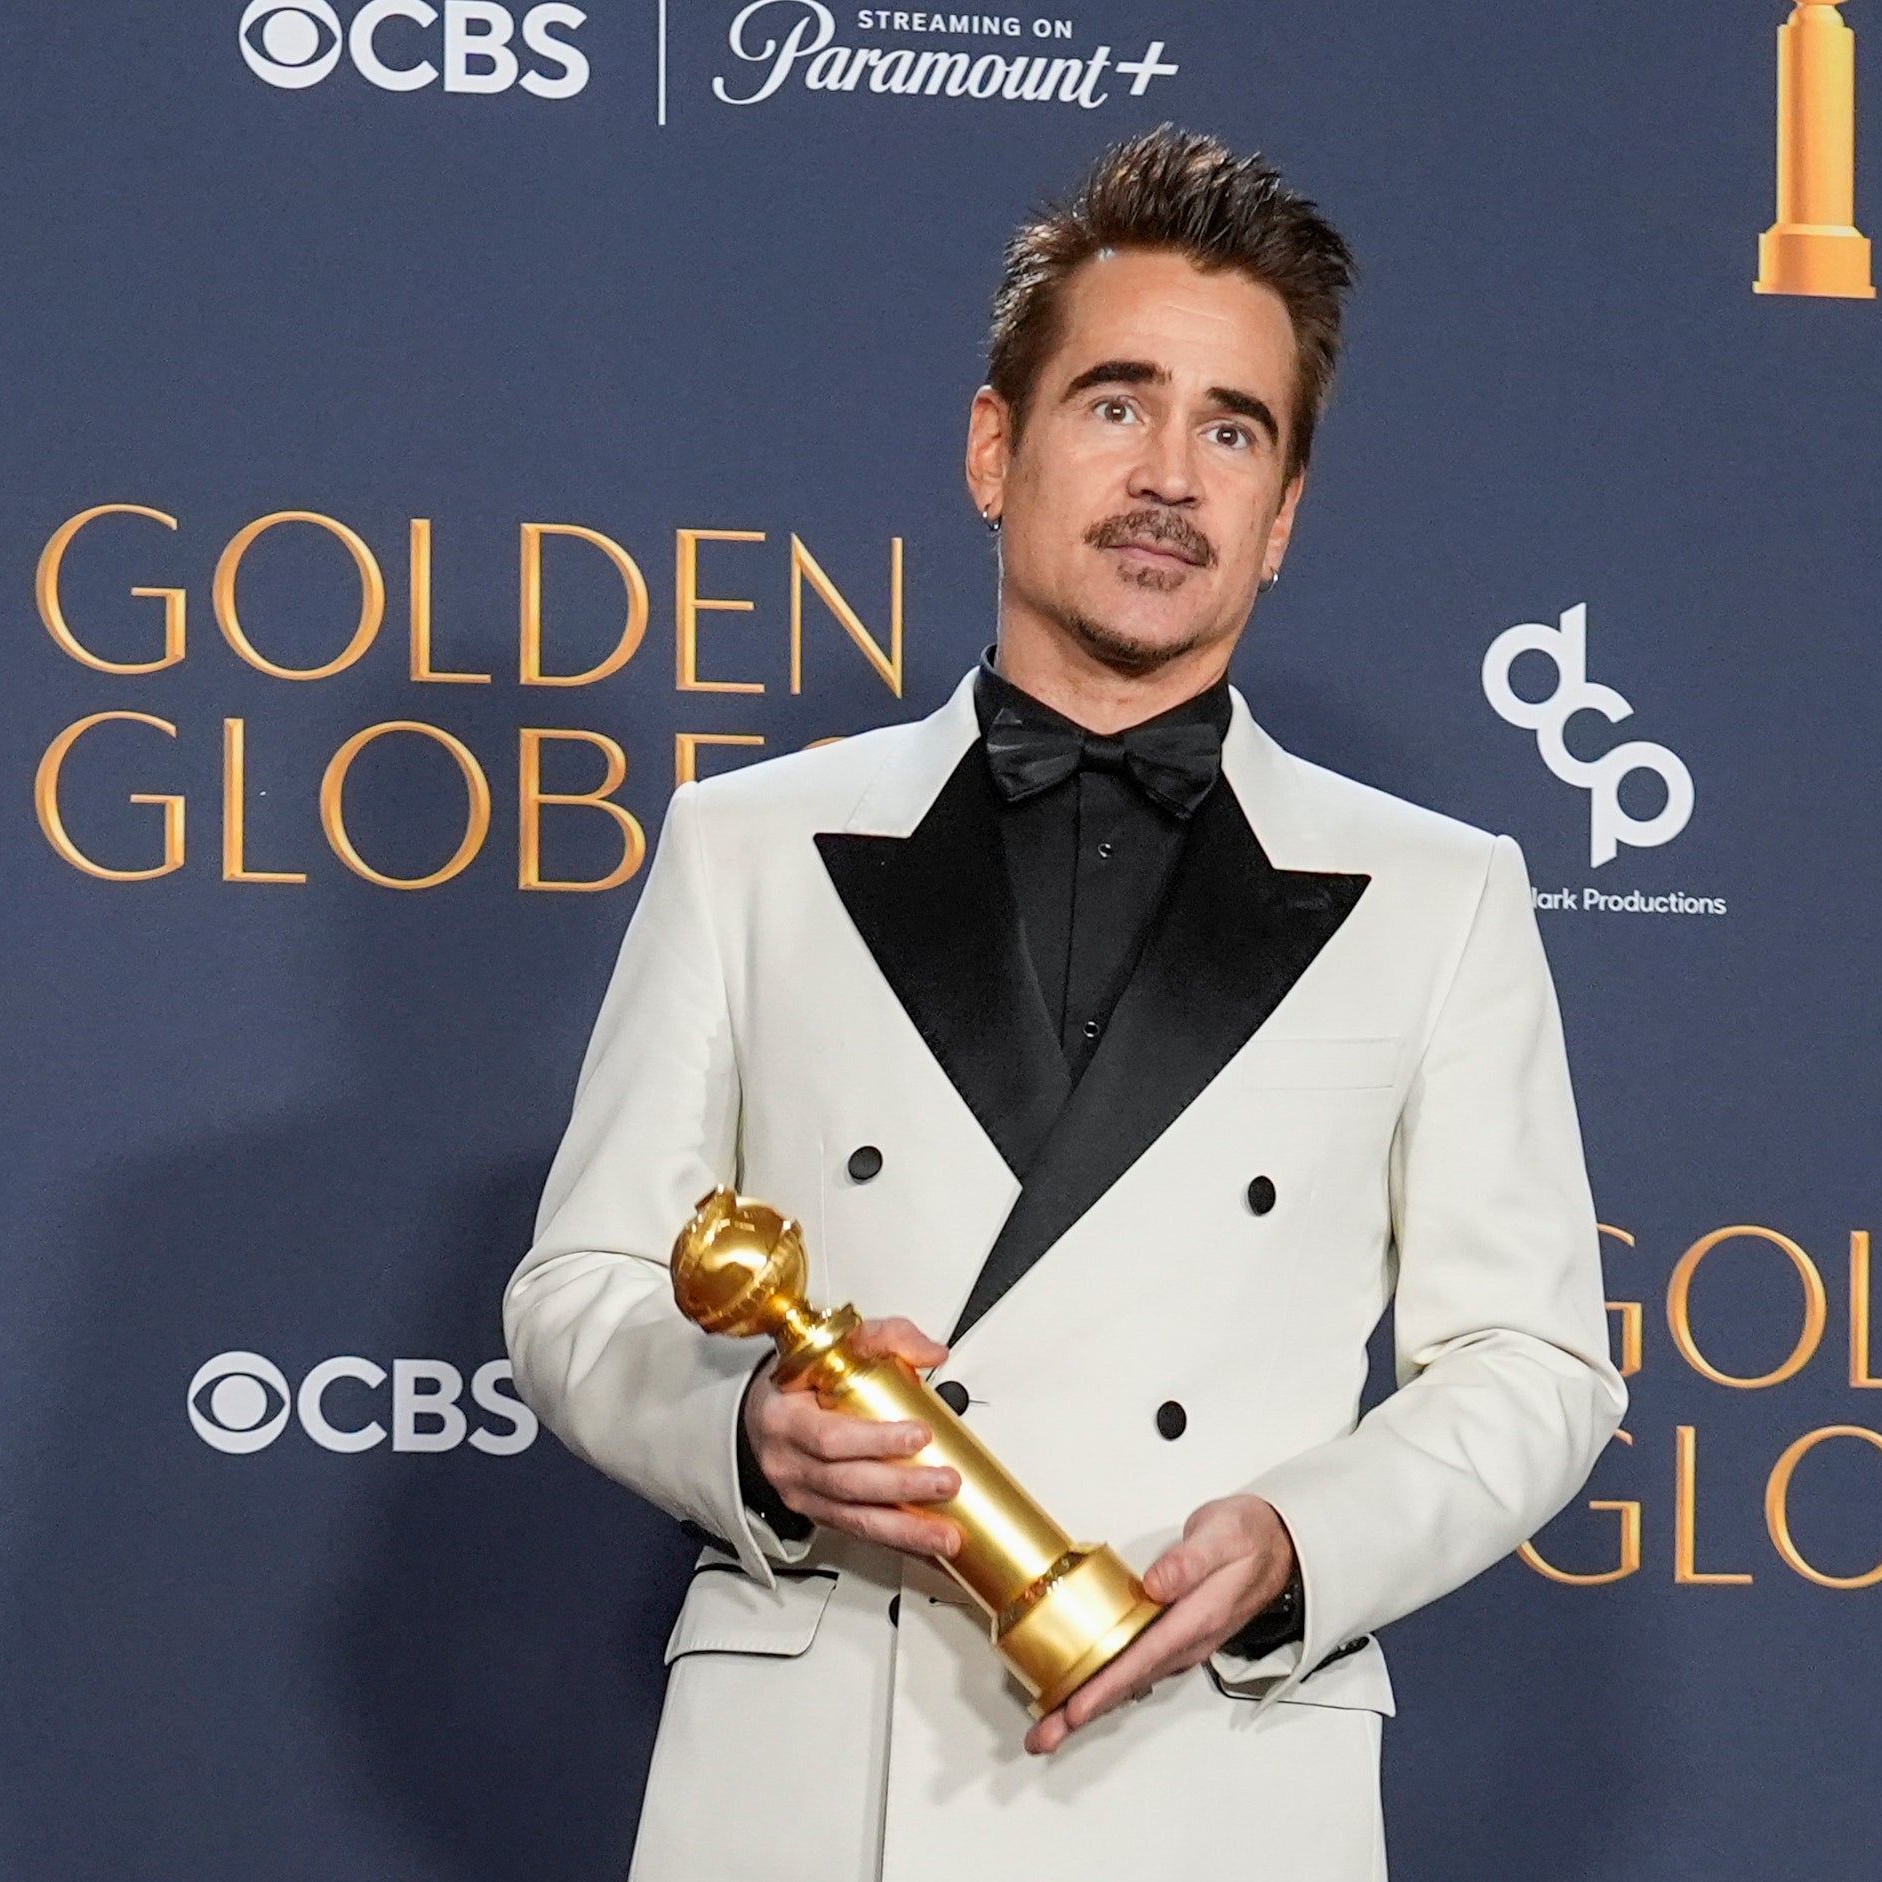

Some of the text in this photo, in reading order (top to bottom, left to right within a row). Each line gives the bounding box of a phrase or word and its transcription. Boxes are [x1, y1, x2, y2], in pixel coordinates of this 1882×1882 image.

[349, 0, 589, 99] CBS
[858, 10, 1073, 39] STREAMING ON
[35, 503, 904, 699] GOLDEN
[34, 710, 846, 893] GLOB
[1531, 886, 1728, 915] lark Productions
[297, 1355, 539, 1456] CBS
